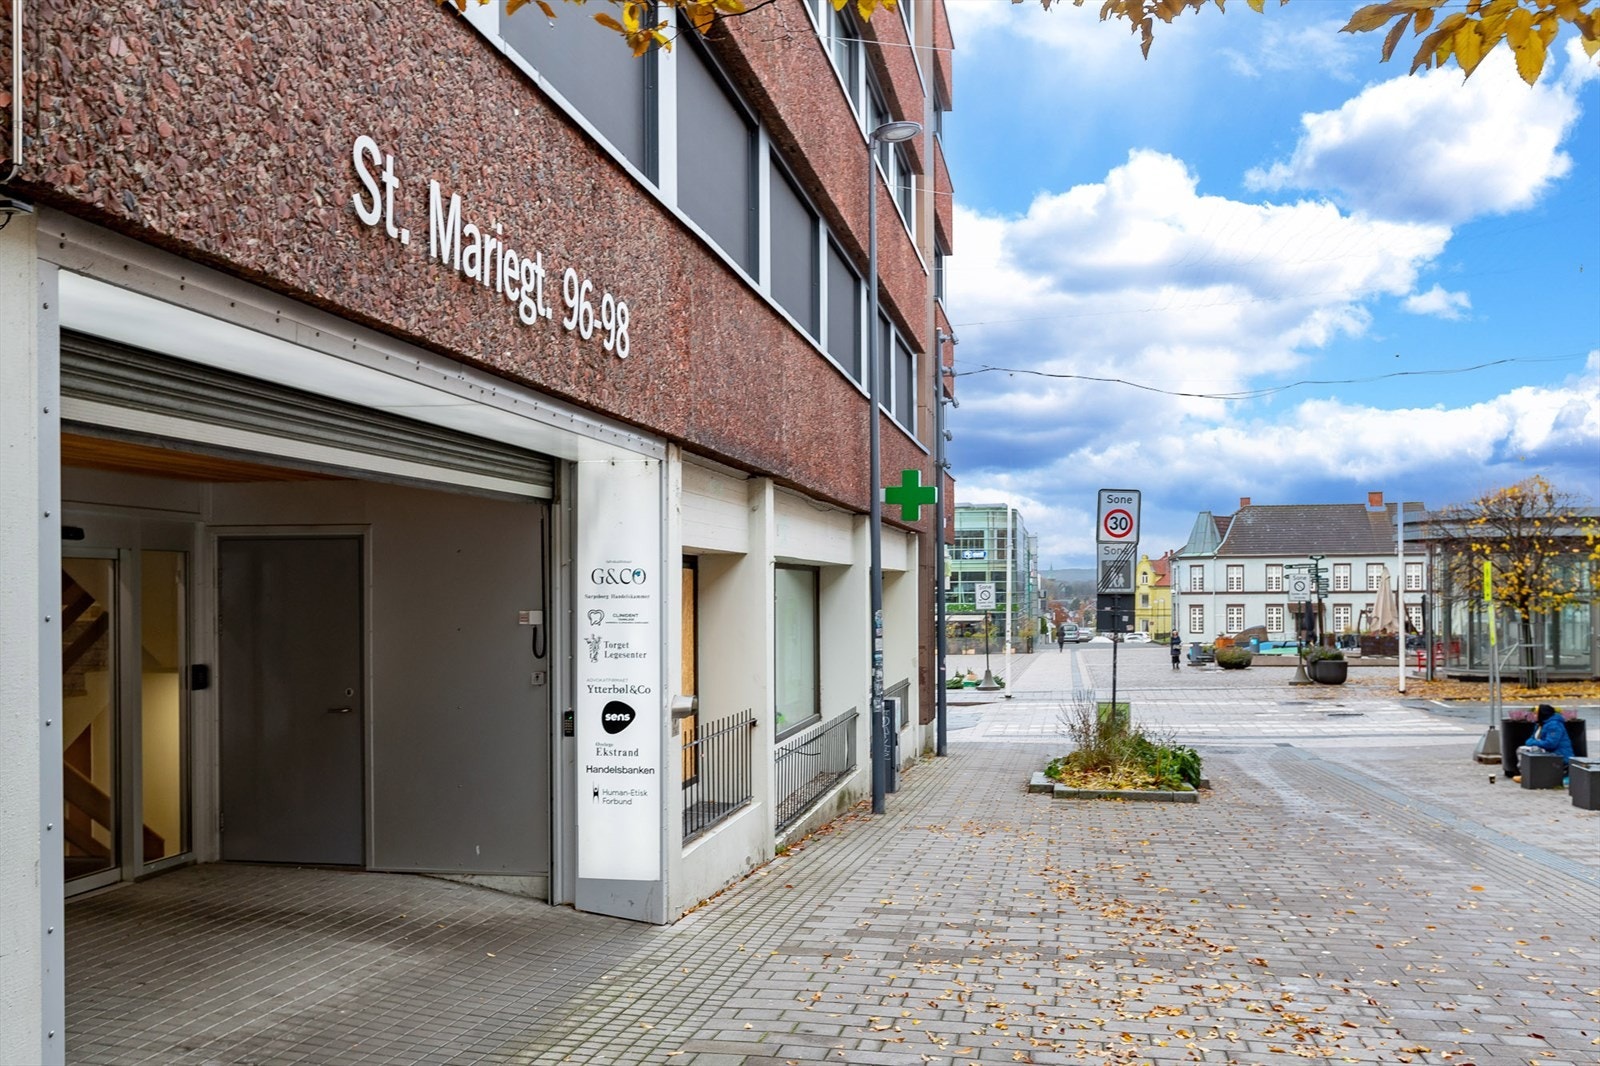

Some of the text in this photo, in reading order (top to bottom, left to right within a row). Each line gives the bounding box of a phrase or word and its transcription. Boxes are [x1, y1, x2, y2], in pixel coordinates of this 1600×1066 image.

[352, 134, 630, 359] St. Mariegt. 96-98
[1106, 494, 1133, 504] Sone
[1109, 516, 1128, 531] 30
[604, 640, 629, 650] Torget
[604, 651, 647, 660] Legesenter
[587, 684, 651, 694] Ytterbøl&Co
[605, 713, 631, 722] sens
[596, 748, 639, 757] Ekstrand
[586, 765, 655, 774] Handelsbanken
[602, 788, 648, 797] Human-Etisk
[602, 797, 632, 806] Forbund
